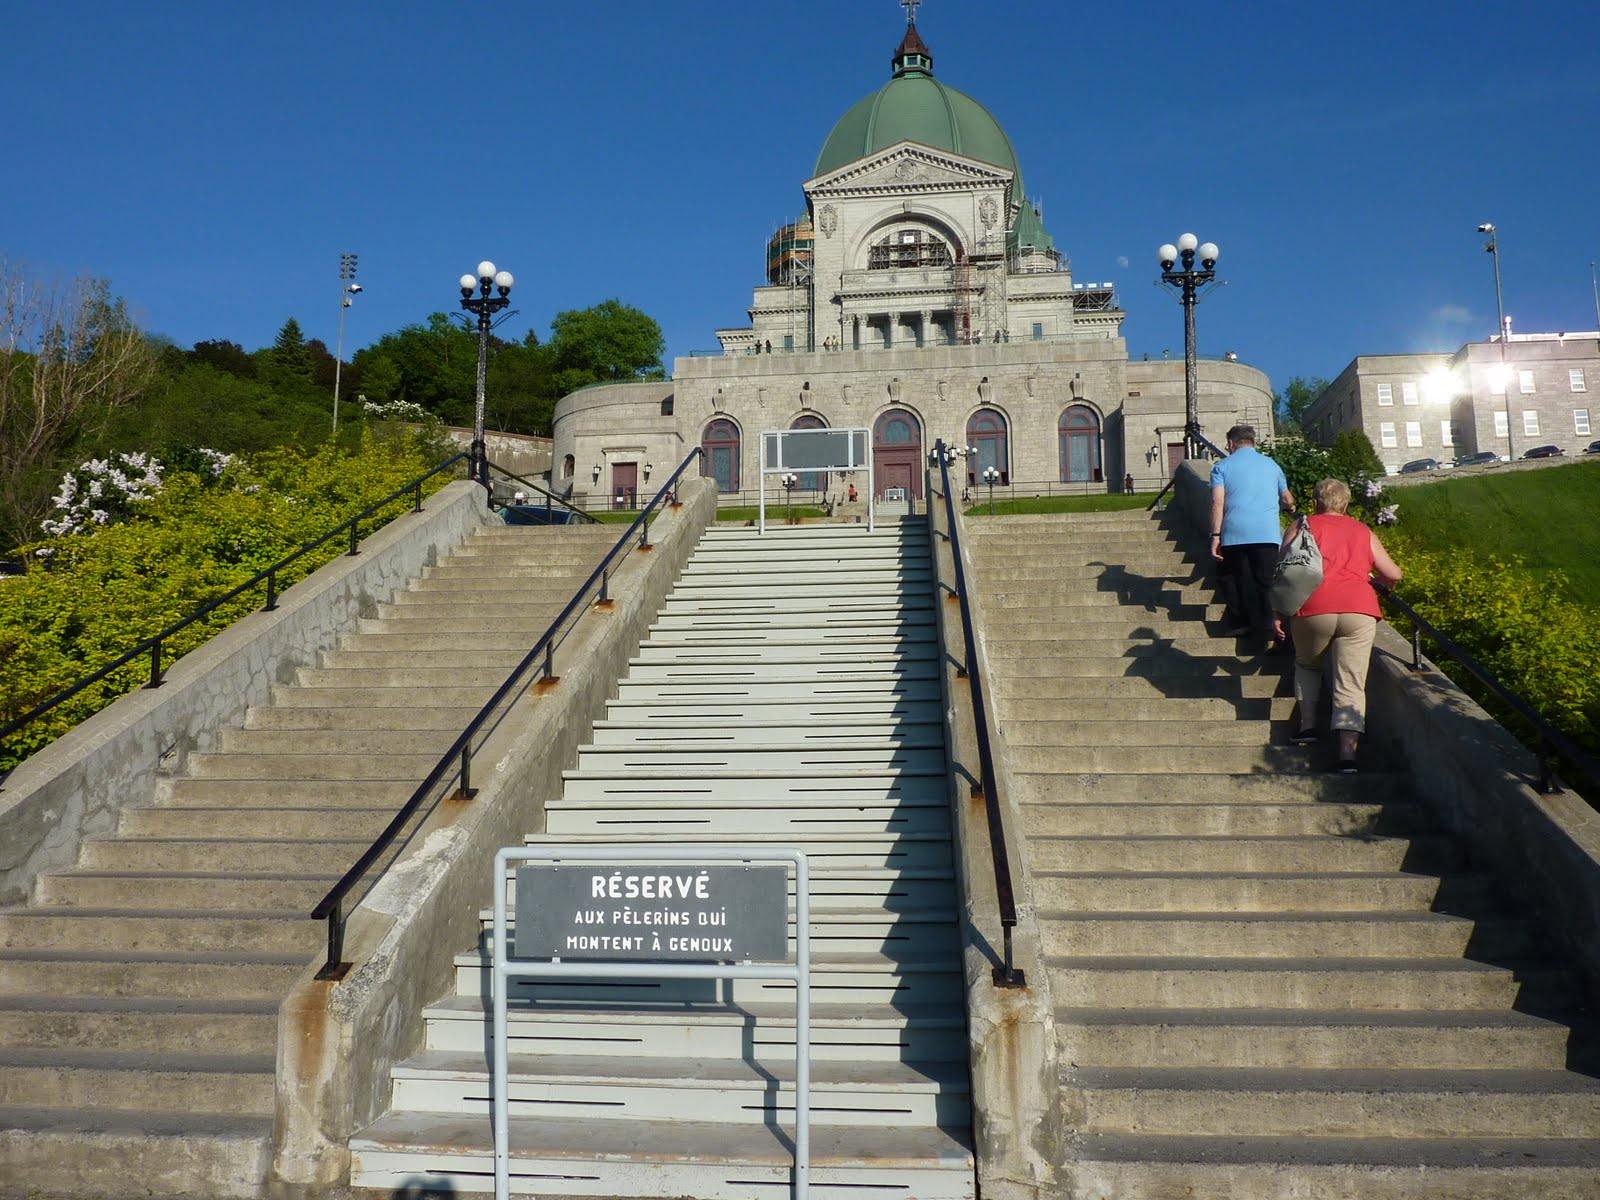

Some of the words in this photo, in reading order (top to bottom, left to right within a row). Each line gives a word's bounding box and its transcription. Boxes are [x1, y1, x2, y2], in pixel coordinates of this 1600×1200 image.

[591, 870, 710, 899] RÉSERVÉ
[574, 910, 605, 925] AUX
[566, 935, 644, 951] MONTENT
[651, 931, 662, 952] À
[669, 936, 733, 953] GENOUX
